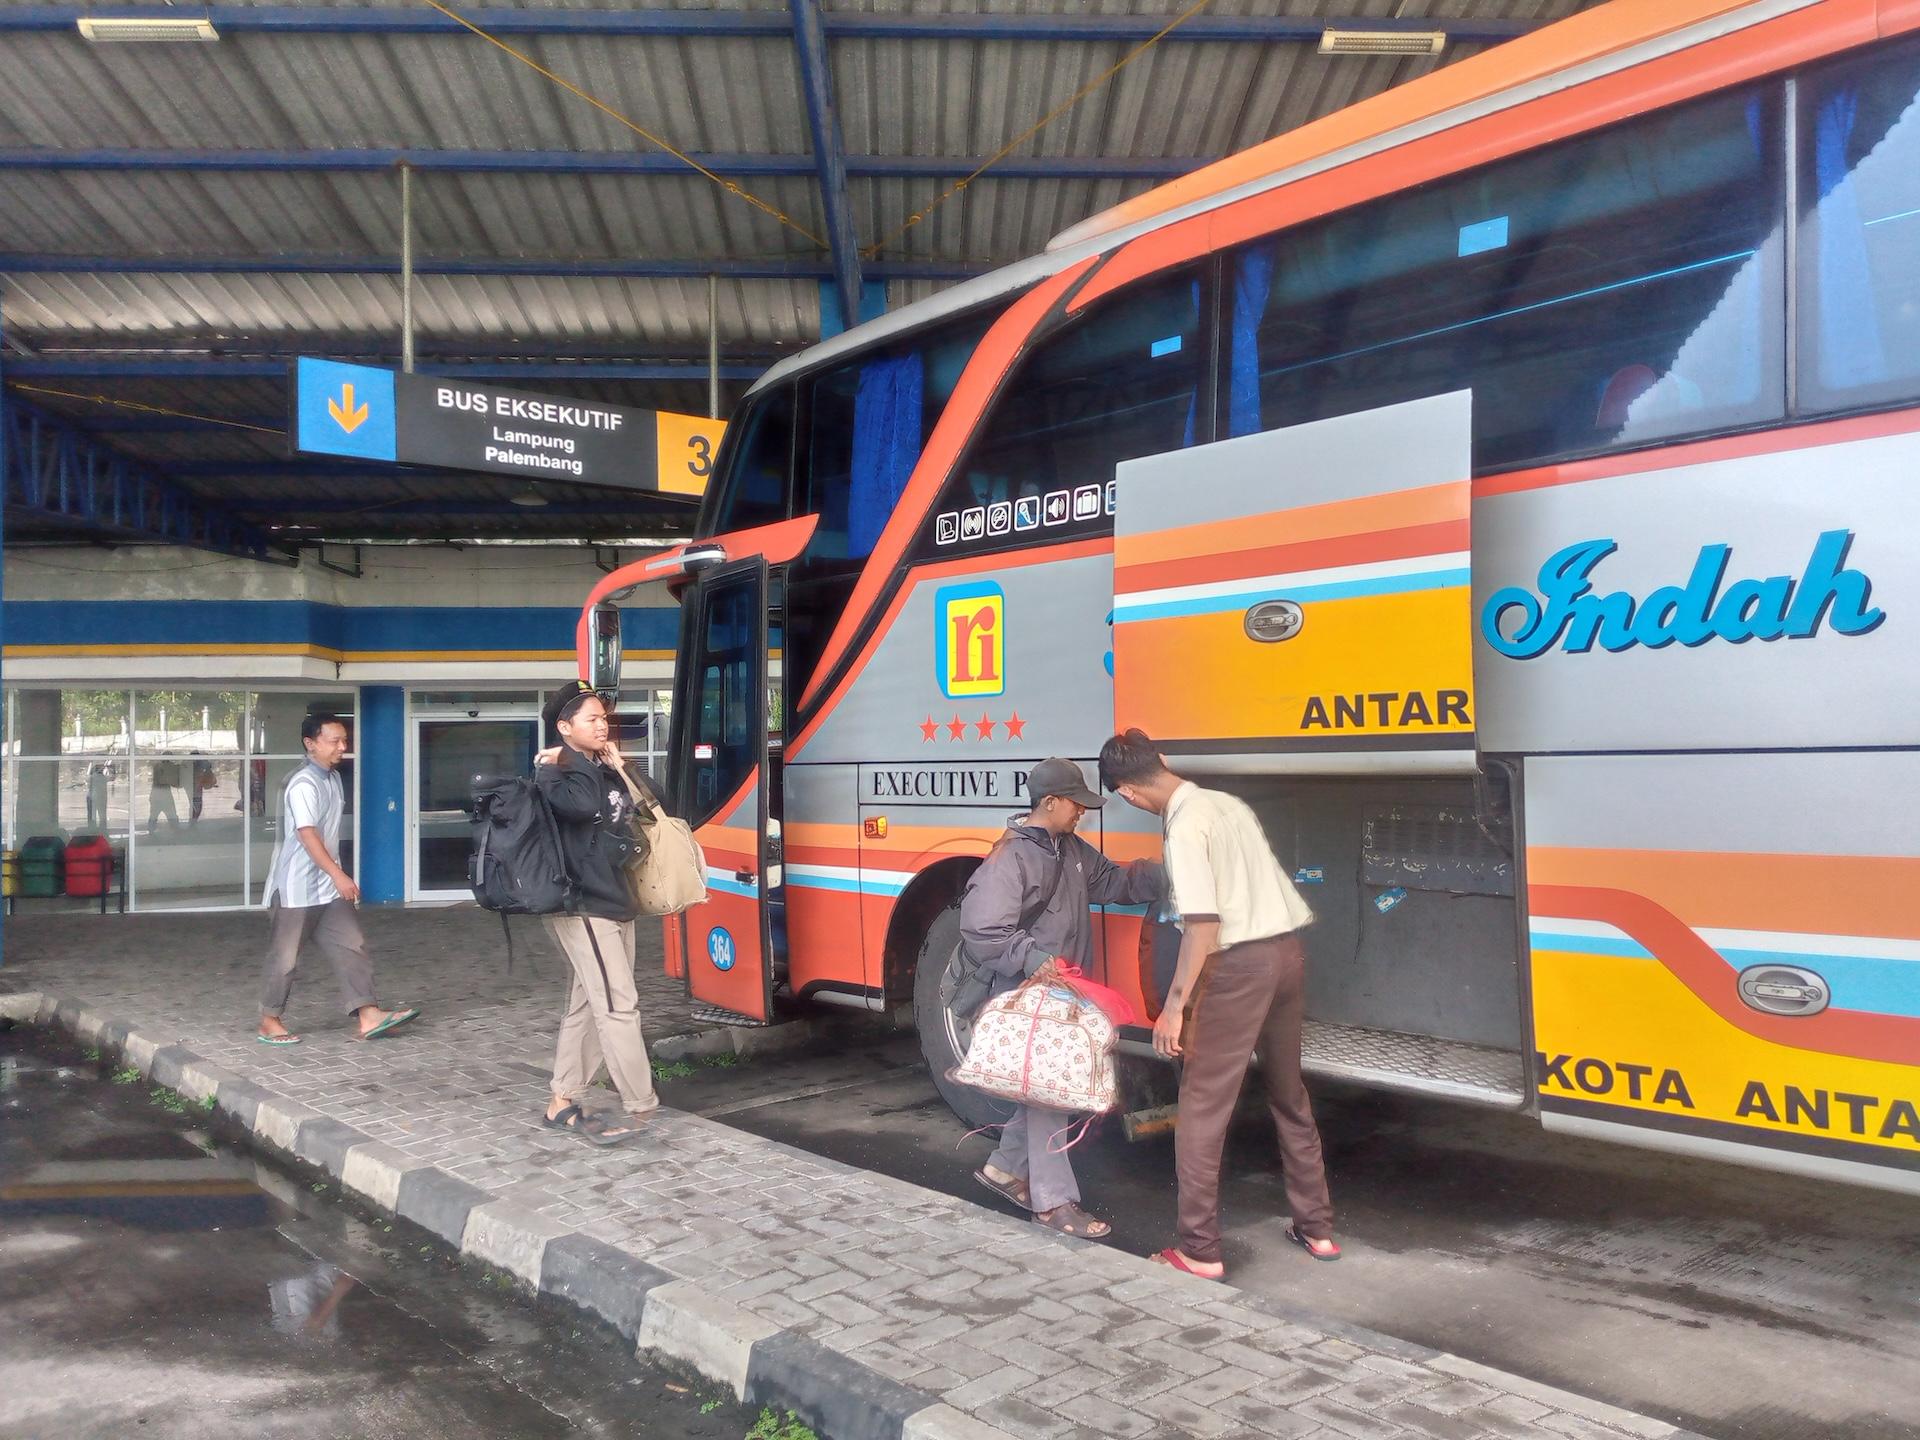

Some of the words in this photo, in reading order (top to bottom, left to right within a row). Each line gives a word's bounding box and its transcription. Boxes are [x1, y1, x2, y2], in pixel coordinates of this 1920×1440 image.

[437, 388, 488, 413] BUS
[495, 397, 622, 431] EKSEKUTIF
[493, 427, 575, 453] Lampung
[687, 435, 712, 476] 3
[485, 446, 583, 475] Palembang
[1480, 528, 1887, 660] Indah
[951, 605, 999, 682] ri
[1300, 689, 1472, 729] ANTAR
[872, 771, 999, 797] EXECUTIVE
[711, 933, 731, 967] 364
[1535, 1051, 1696, 1109] KOTA
